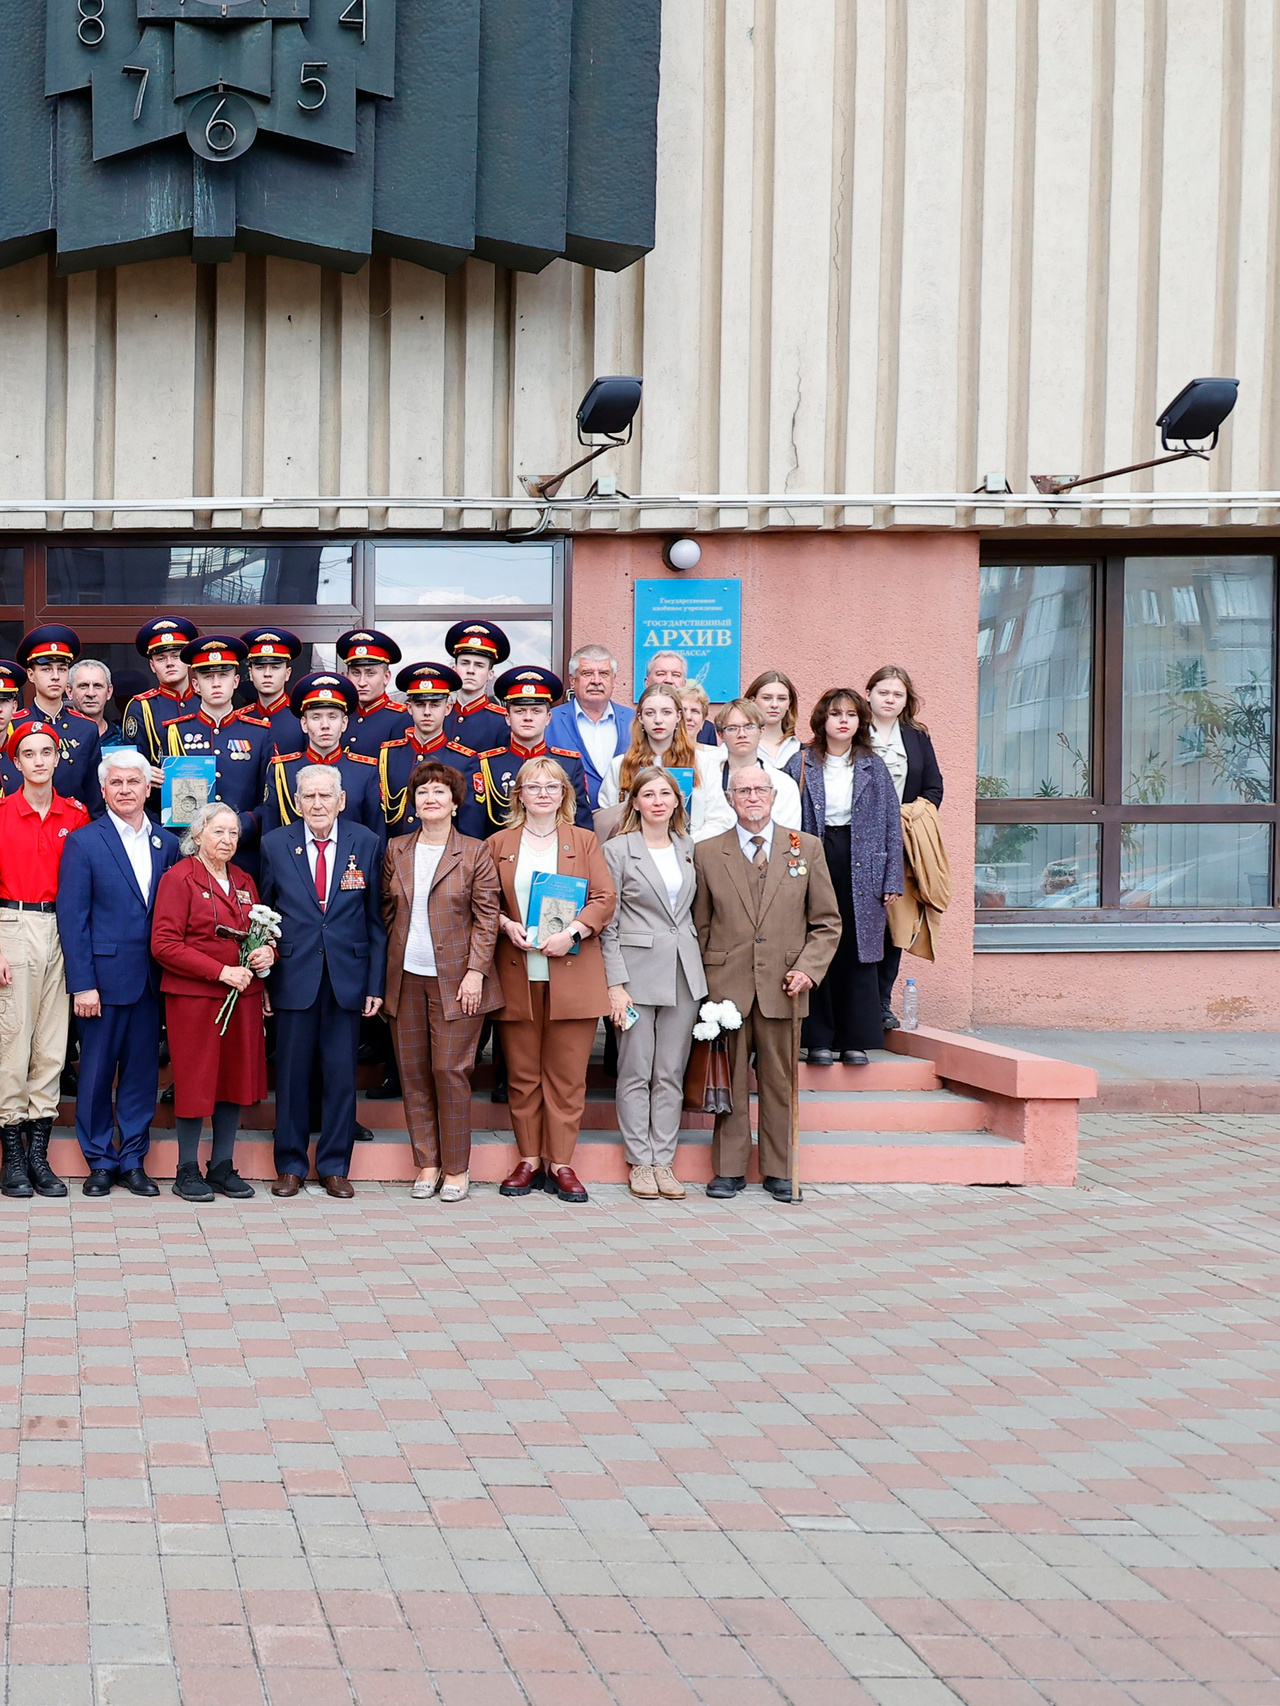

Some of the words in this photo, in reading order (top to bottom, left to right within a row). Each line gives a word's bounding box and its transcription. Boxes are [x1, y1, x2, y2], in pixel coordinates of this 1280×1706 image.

[77, 0, 105, 45] 8
[338, 0, 367, 45] 4
[121, 64, 150, 121] 7
[296, 61, 328, 110] 5
[205, 97, 237, 151] 6
[643, 629, 732, 647] АРХИВ
